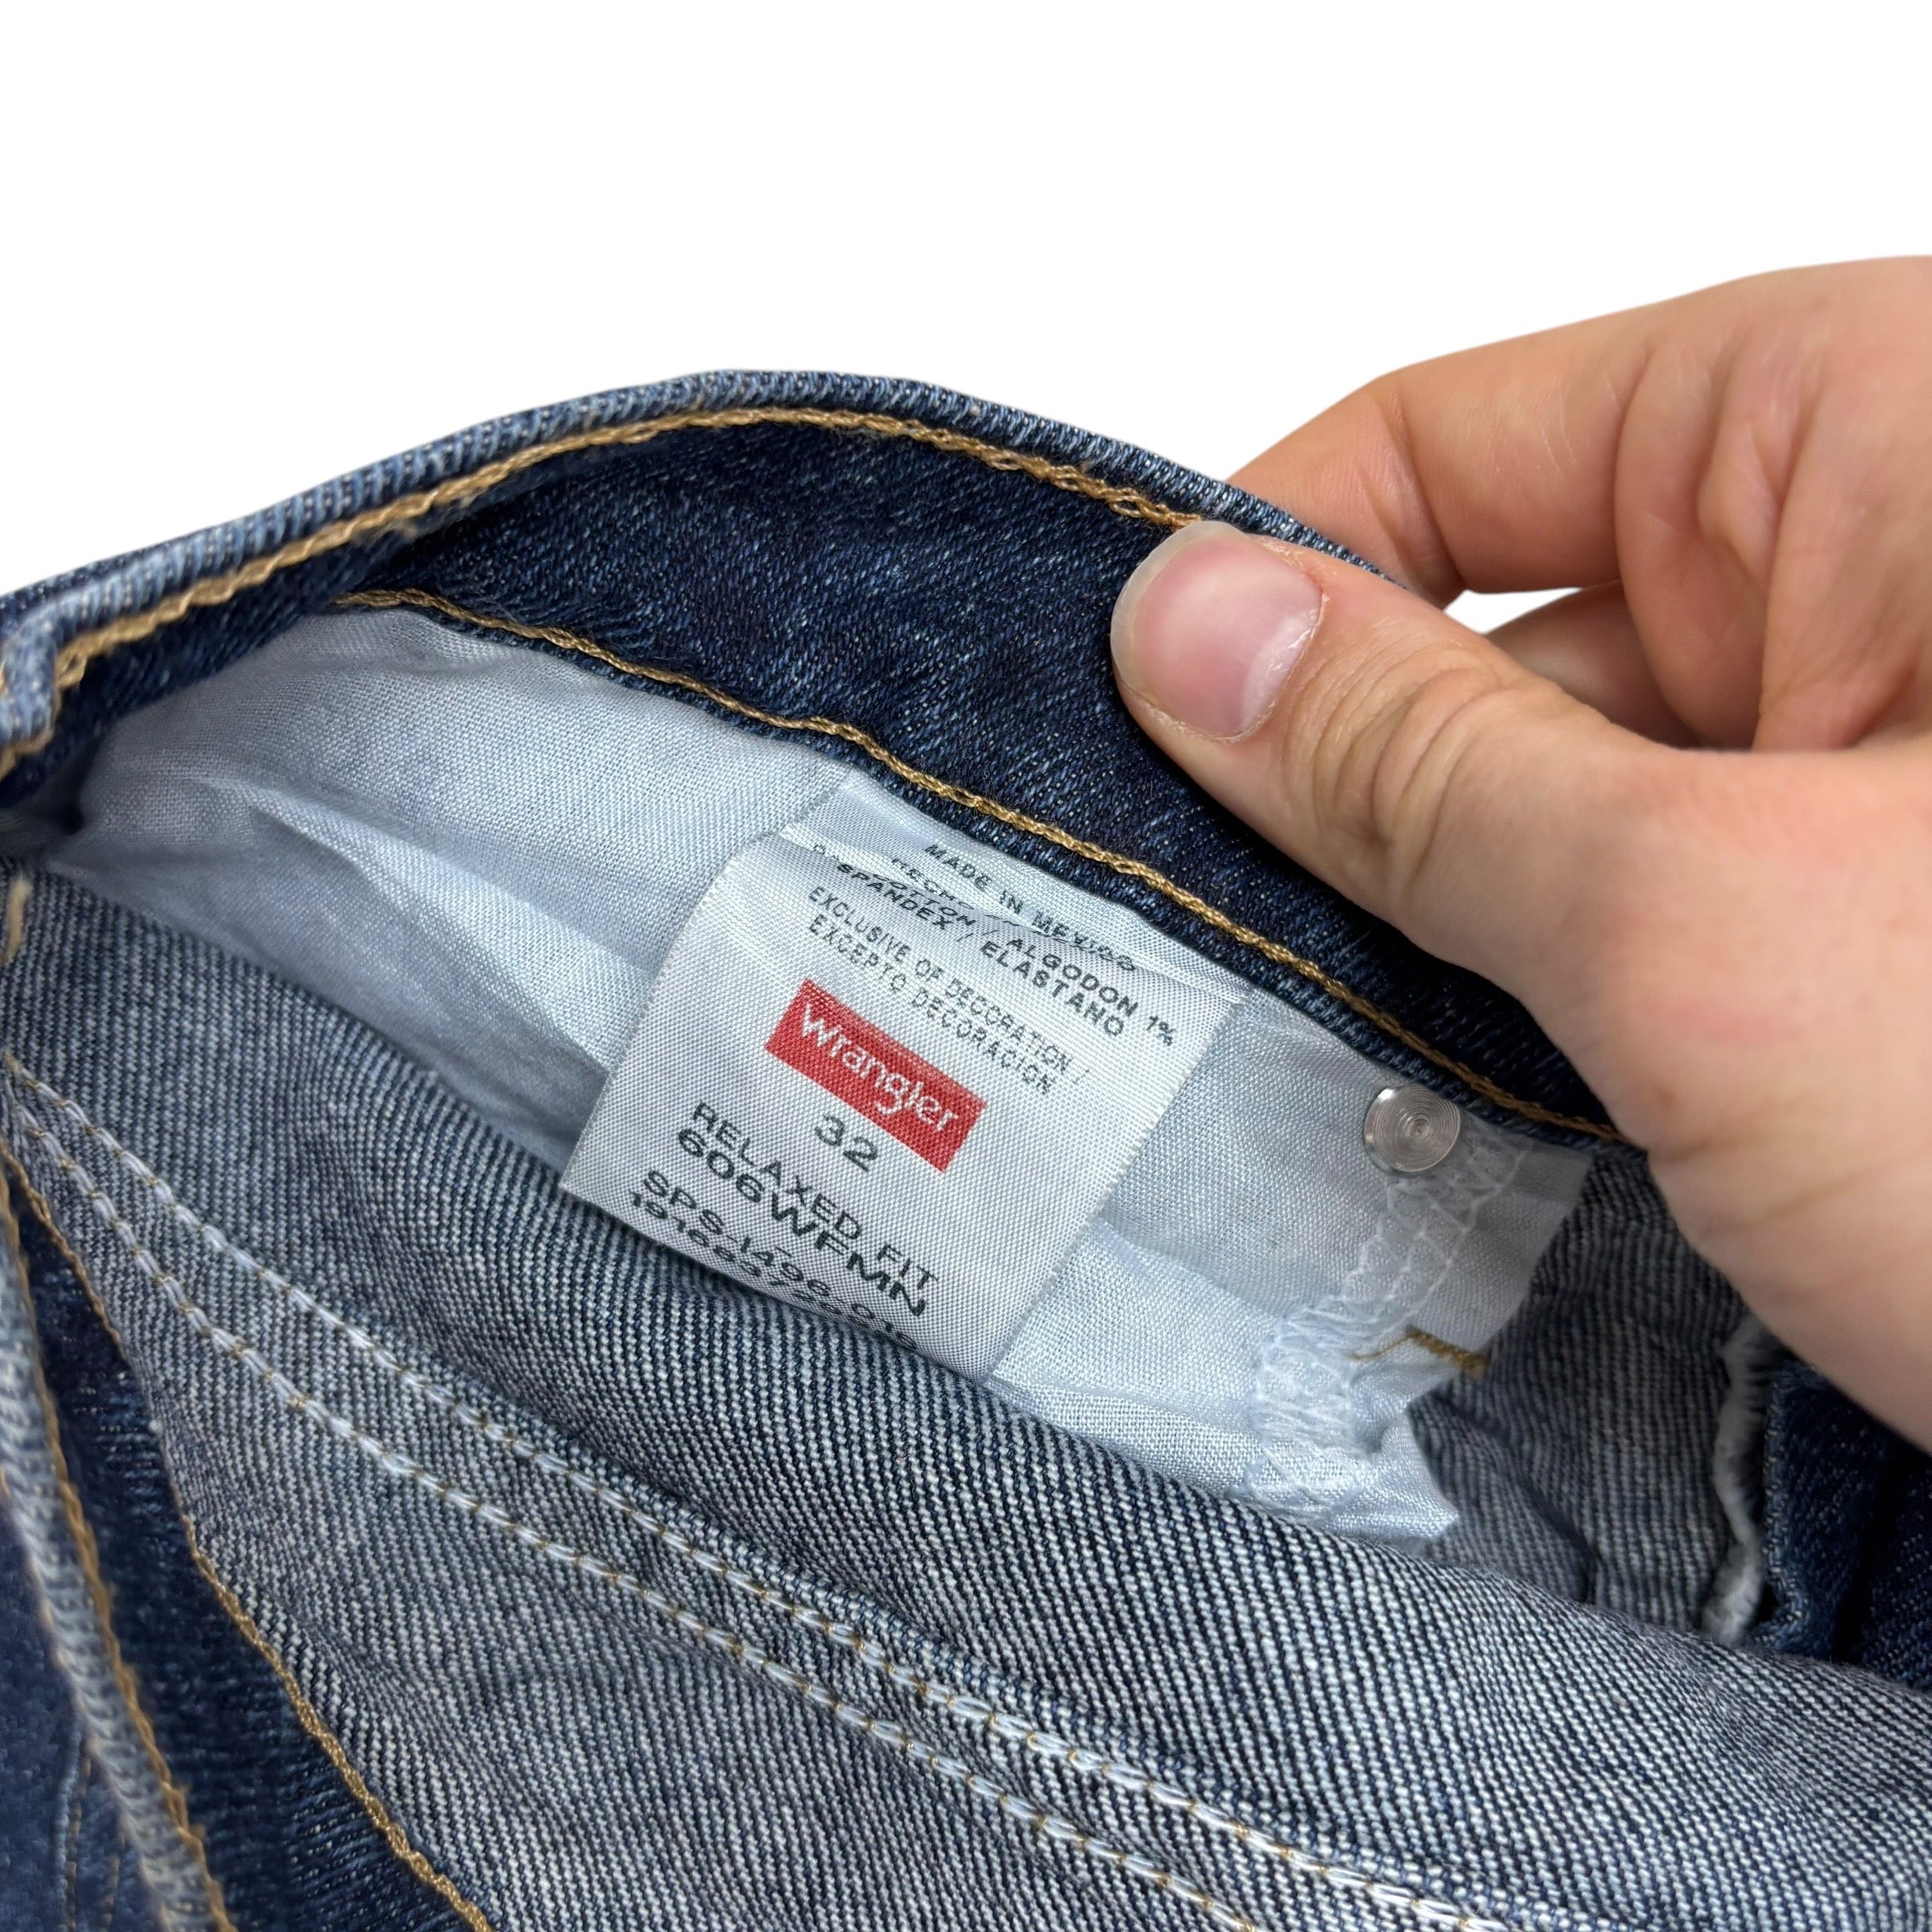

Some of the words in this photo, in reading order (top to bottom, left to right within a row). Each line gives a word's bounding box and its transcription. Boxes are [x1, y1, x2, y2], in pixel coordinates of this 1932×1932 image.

[837, 864, 954, 931] SPANDEX
[980, 939, 1125, 1037] ELASTANO
[873, 873, 976, 926] COTTON
[1006, 937, 1138, 1018] ALGODON
[1146, 1015, 1177, 1046] 1%
[925, 844, 992, 892] MADE
[1000, 890, 1023, 914] IN
[800, 1001, 960, 1133] Wrangler
[807, 886, 911, 964] EXCLUSIVE
[914, 957, 945, 982] OF
[944, 977, 1073, 1075] DECORATION
[808, 913, 907, 993] EXCEPTO
[911, 988, 1057, 1096] DECORACION
[678, 1128, 926, 1318] 606WFMN
[691, 1100, 863, 1241] RELAXED
[876, 1244, 939, 1291] FIT
[815, 1113, 878, 1173] 32
